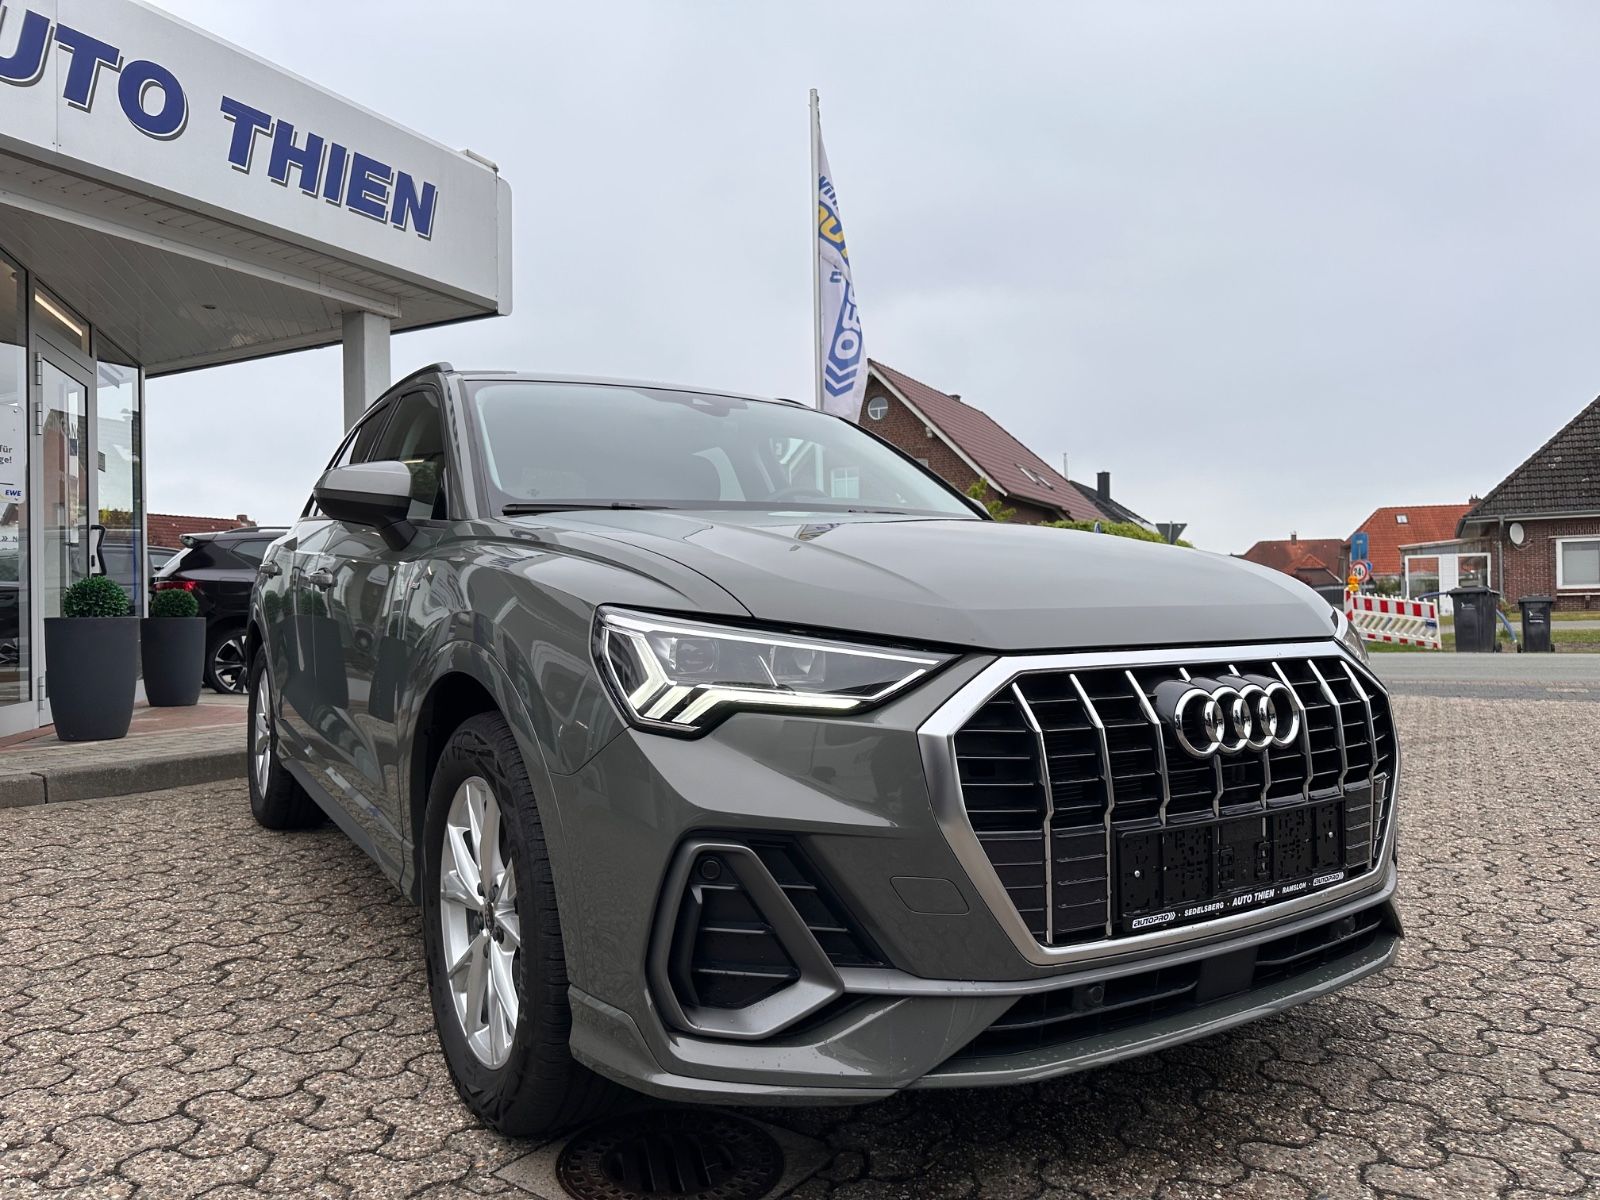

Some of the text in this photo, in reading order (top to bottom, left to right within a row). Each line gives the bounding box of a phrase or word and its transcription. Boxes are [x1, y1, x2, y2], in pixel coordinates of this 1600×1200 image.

[220, 96, 438, 240] THIEN
[1184, 902, 1224, 917] SEDELSBERG
[1232, 894, 1253, 907] AUTO
[1254, 889, 1275, 901] THIEN
